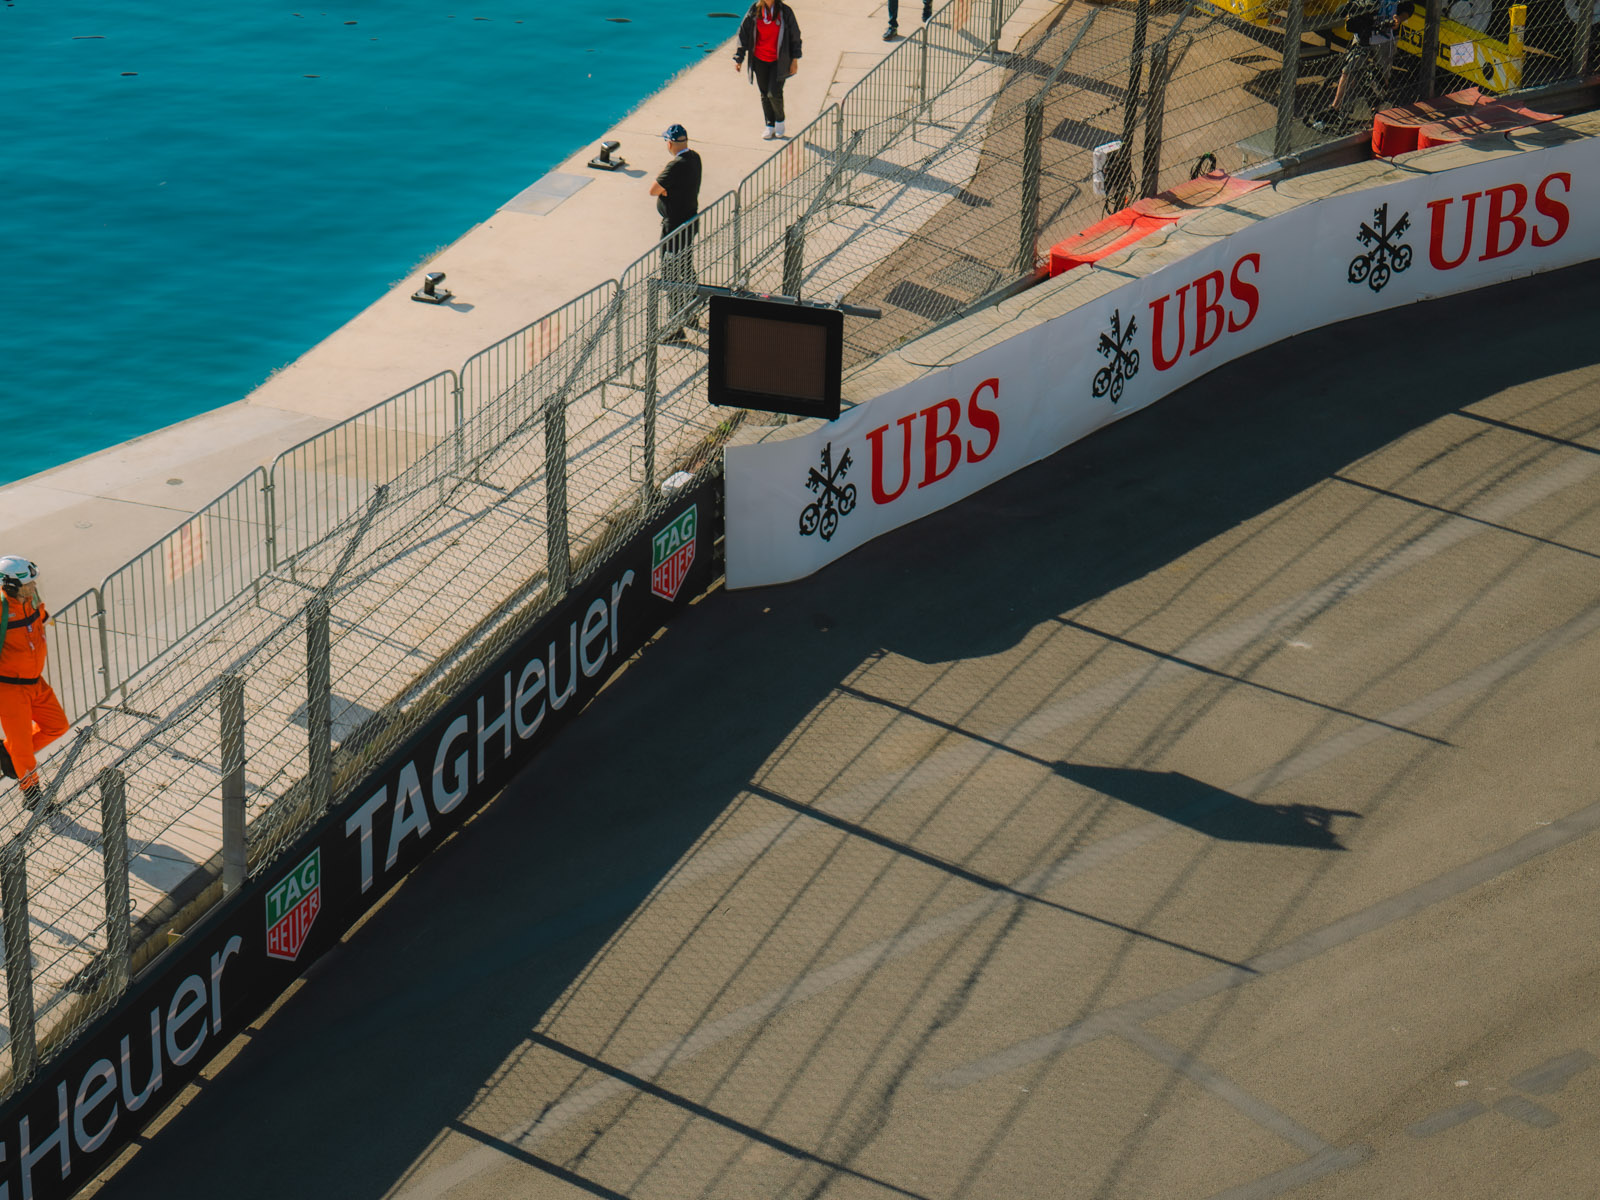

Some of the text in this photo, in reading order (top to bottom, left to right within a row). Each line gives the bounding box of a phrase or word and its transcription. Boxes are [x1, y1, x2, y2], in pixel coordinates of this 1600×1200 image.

[1427, 172, 1571, 271] UBS
[1149, 252, 1261, 372] UBS
[866, 377, 1000, 505] UBS
[656, 513, 693, 561] TAG
[654, 542, 693, 595] HEUER
[270, 858, 316, 918] TAG
[269, 892, 318, 954] HEUER
